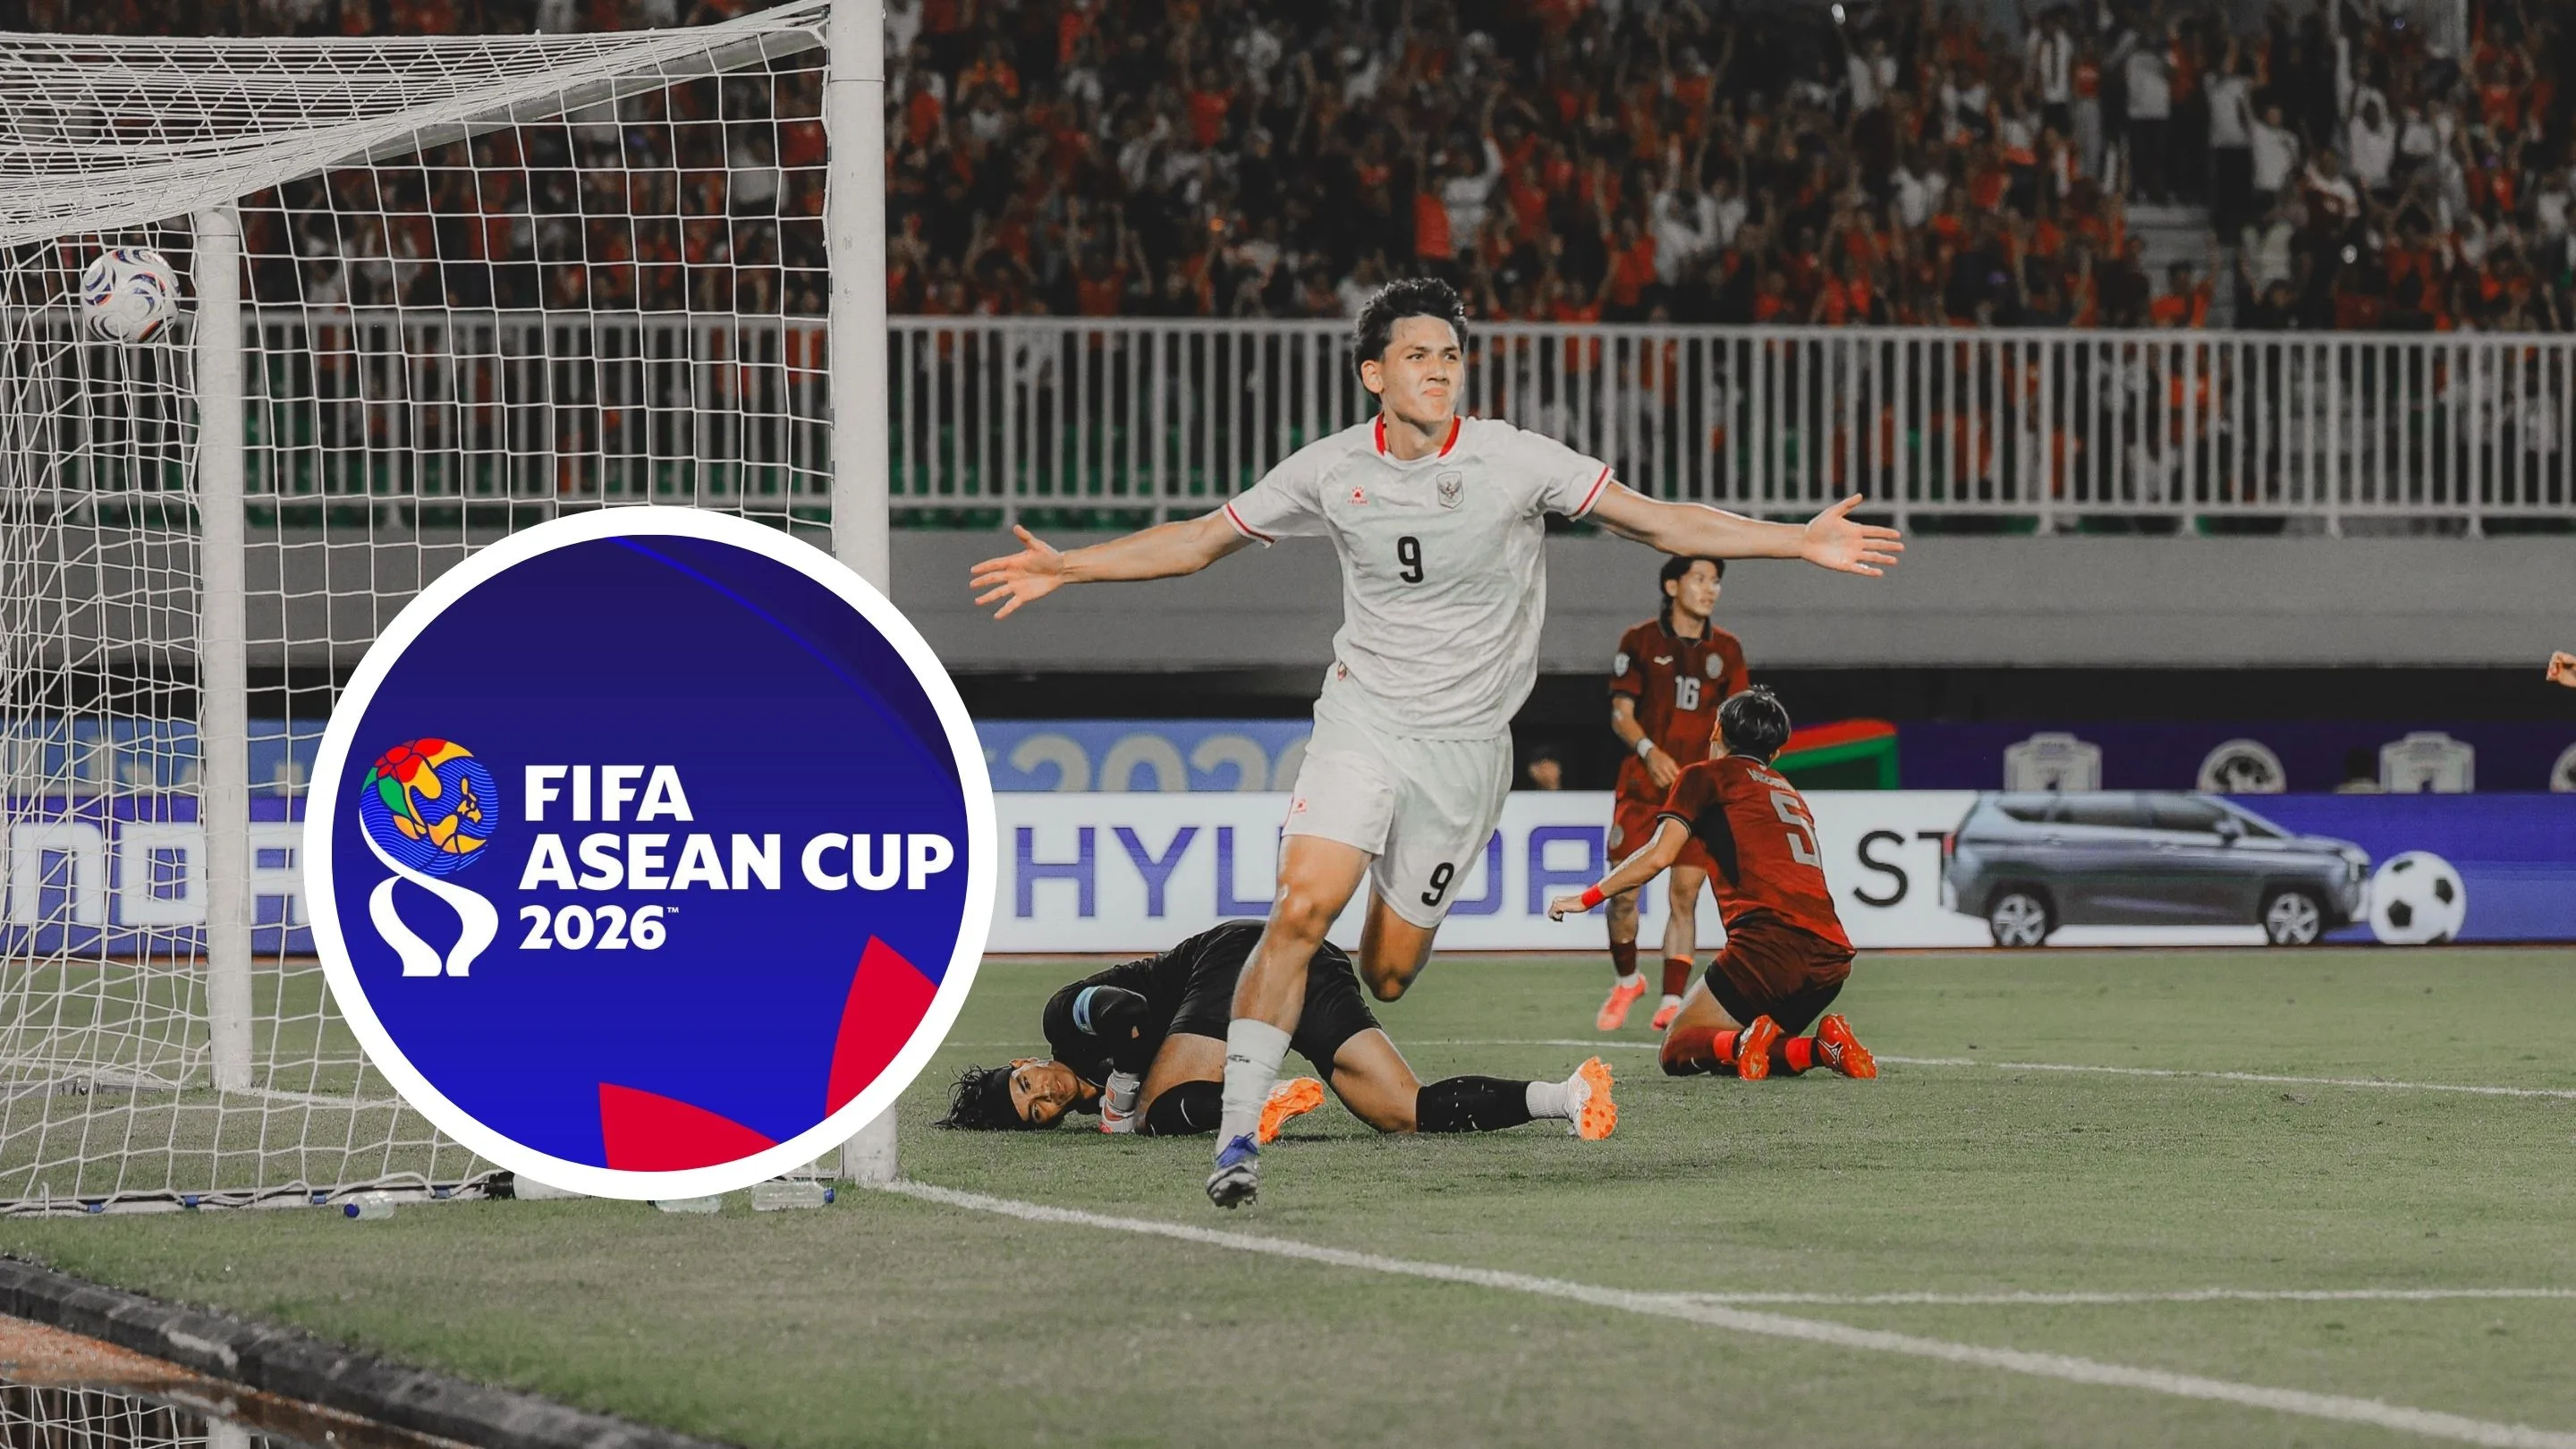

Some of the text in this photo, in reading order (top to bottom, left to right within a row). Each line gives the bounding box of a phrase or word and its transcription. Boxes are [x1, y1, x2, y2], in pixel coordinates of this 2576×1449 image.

[1397, 536, 1424, 584] 9
[1674, 674, 1700, 711] 16
[1769, 790, 1823, 869] 5
[1420, 861, 1455, 907] 9
